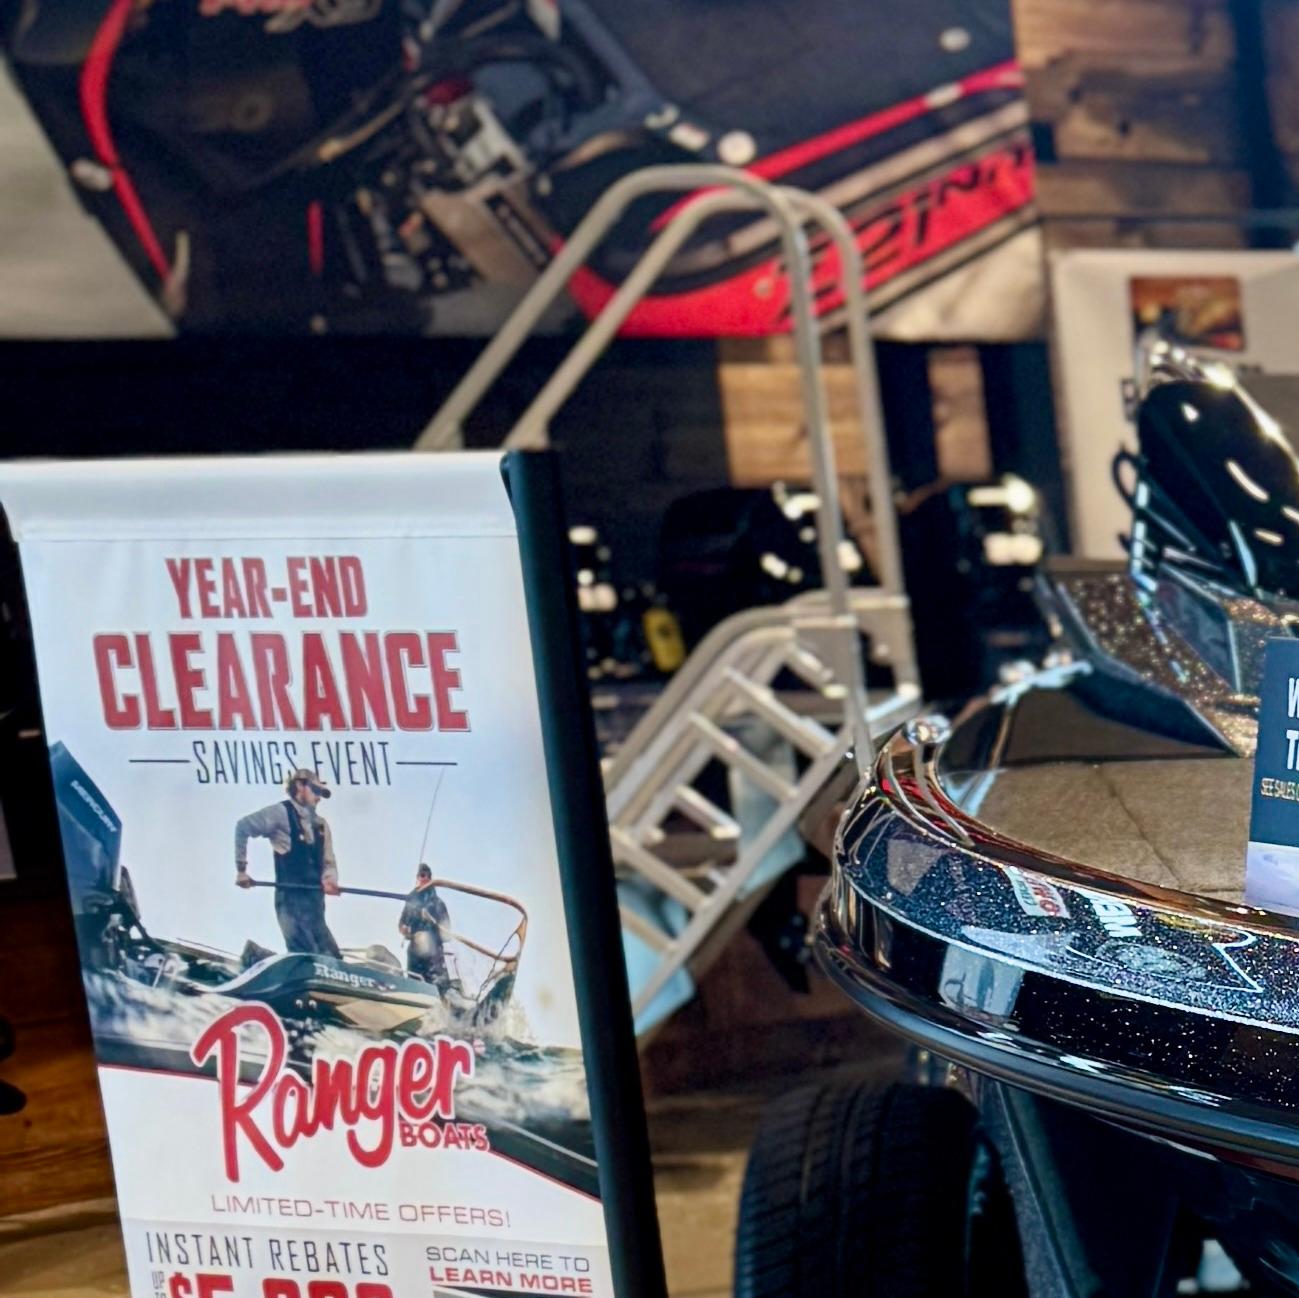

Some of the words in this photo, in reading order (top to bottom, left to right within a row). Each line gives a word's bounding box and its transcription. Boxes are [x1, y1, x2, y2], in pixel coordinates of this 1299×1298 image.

[165, 555, 368, 619] YEAR-END
[93, 630, 471, 732] CLEARANCE
[192, 741, 298, 785] SAVINGS
[311, 741, 392, 786] EVENT
[1261, 777, 1275, 797] SEE
[190, 1003, 475, 1184] Ranger
[399, 1121, 490, 1151] BOATS
[211, 1194, 391, 1221] LIMITED-TIME
[399, 1204, 512, 1228] OFFERS!
[146, 1231, 254, 1269] INSTANT
[269, 1238, 389, 1277] REBATES
[426, 1246, 490, 1265] SCAN
[497, 1251, 553, 1270] HERE
[558, 1255, 590, 1273] TO
[429, 1266, 513, 1286] LEARN
[519, 1273, 593, 1294] MORE
